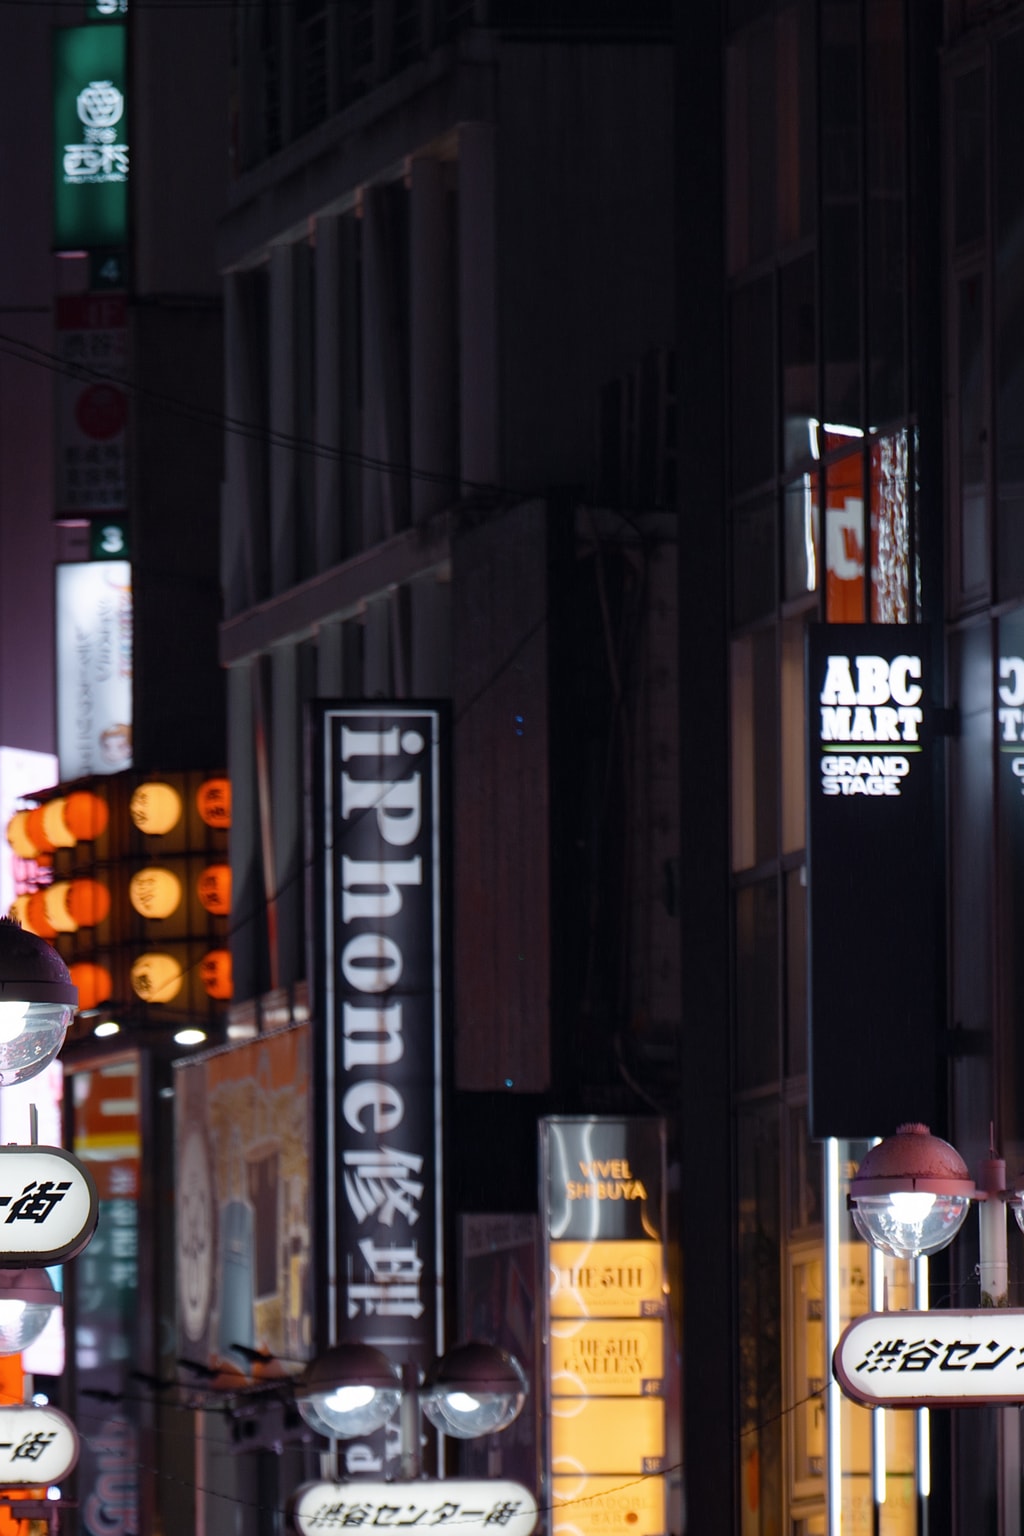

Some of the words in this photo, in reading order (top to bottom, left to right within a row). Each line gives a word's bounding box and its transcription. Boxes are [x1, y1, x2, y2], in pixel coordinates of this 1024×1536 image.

[820, 656, 923, 706] ABC
[820, 706, 923, 741] MART
[821, 756, 910, 777] GRAND
[821, 776, 902, 796] STAGE
[342, 724, 424, 1320] iPhone修理
[566, 1182, 648, 1201] SHIBUYA
[855, 1339, 1024, 1373] 渋谷セン
[307, 1501, 522, 1528] 渋谷センター街
